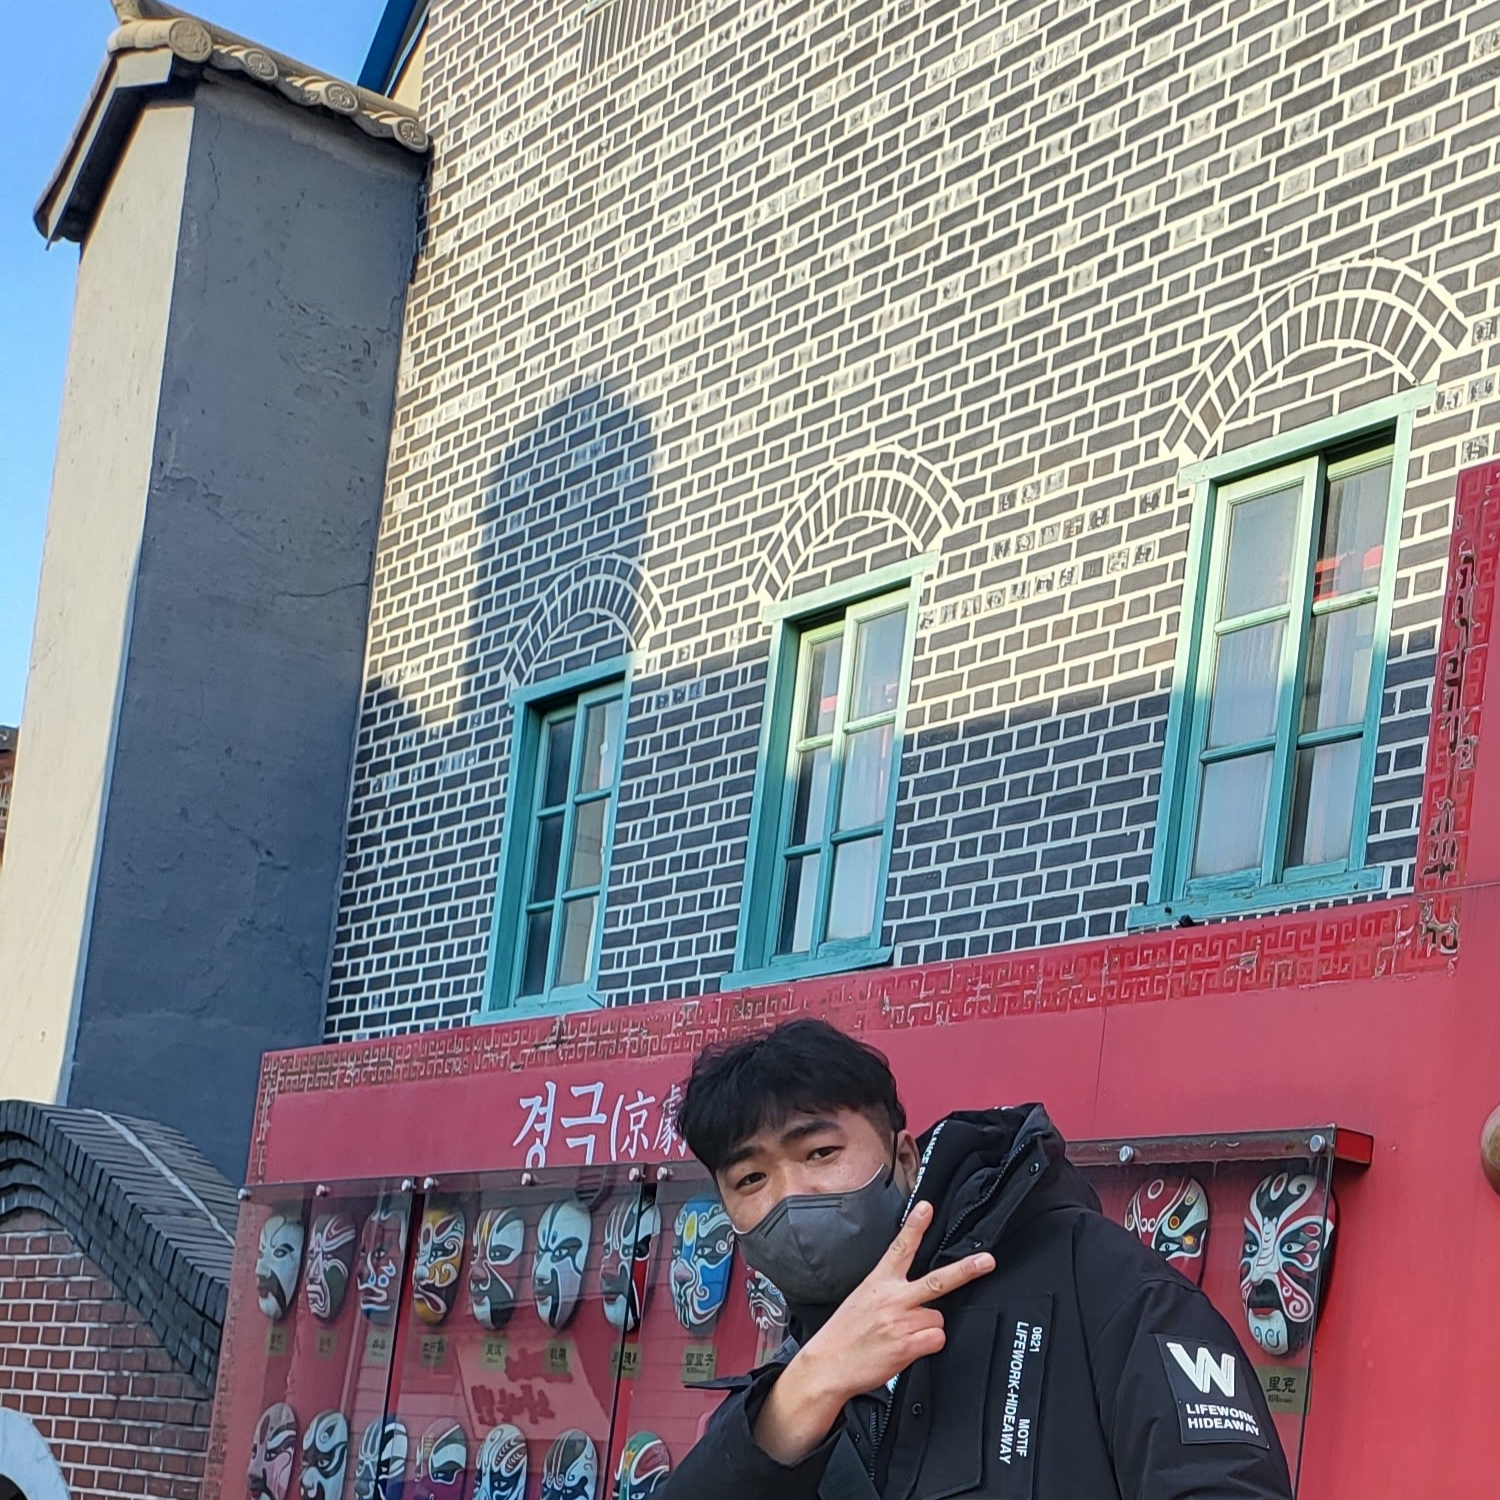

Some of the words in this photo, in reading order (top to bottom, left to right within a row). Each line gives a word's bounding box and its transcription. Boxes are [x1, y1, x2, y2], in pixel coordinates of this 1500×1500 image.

[1030, 1326, 1043, 1352] 0621
[999, 1320, 1030, 1465] LIFEWORK-HIDEAWAY
[1185, 1403, 1257, 1425] LIFEWORK
[1187, 1417, 1259, 1436] HIDEAWAY
[1016, 1418, 1031, 1457] MOTIF
